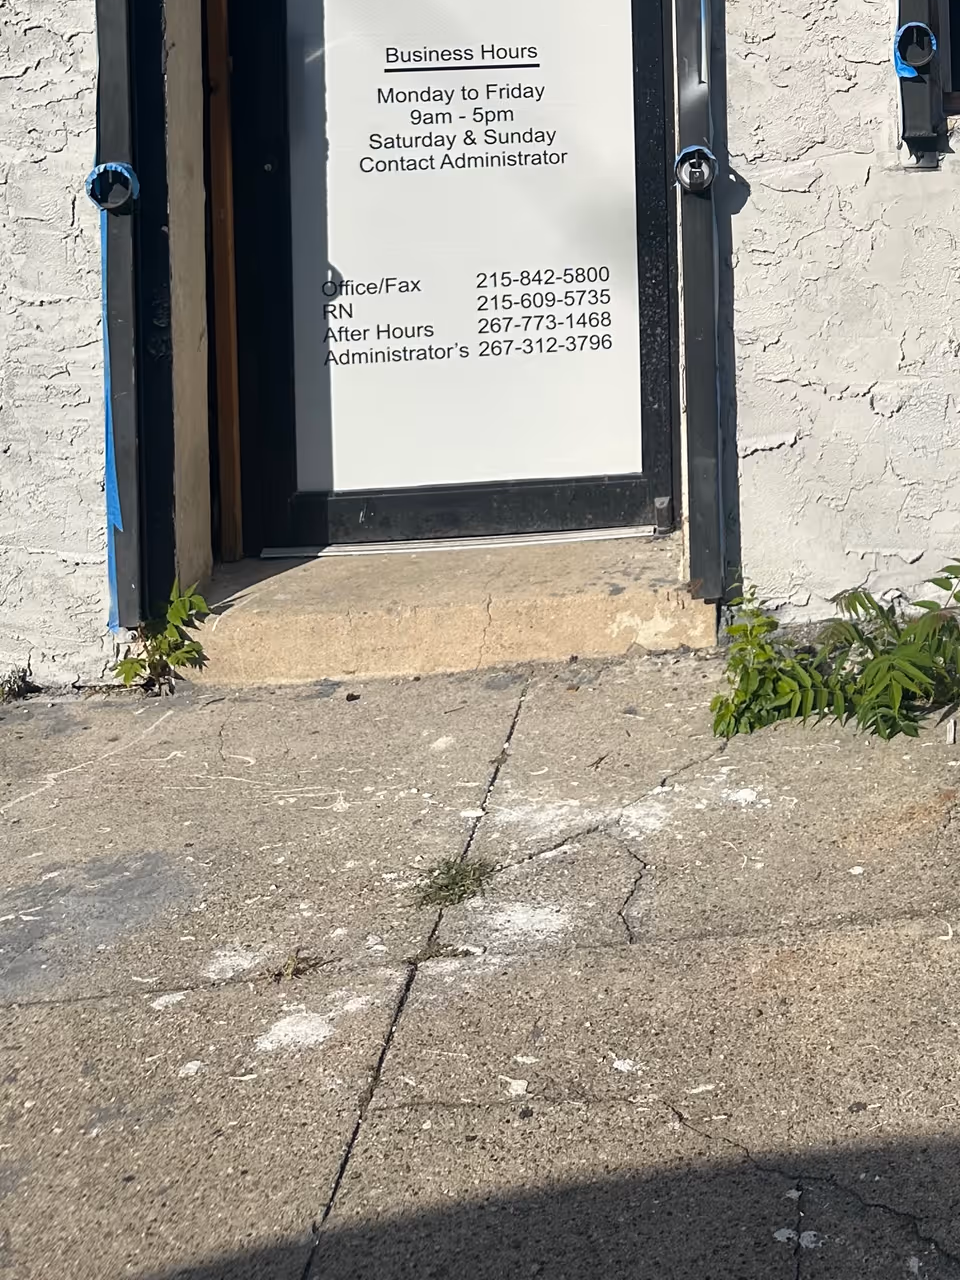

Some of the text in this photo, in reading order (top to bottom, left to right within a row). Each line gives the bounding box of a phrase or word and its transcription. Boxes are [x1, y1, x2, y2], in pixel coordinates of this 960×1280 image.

[385, 44, 538, 63] Business Hours
[377, 83, 545, 105] Monday to Friday
[410, 109, 452, 125] 9am
[472, 107, 514, 126] 5pm
[369, 127, 556, 151] Saturday & Sunday
[359, 150, 567, 173] Contact Administrator
[321, 266, 610, 297] Office/Fax 215-842-5800
[323, 288, 611, 320] RN 215-609-5735
[323, 311, 612, 343] After Hours 267-773-1468
[324, 333, 613, 366] Administrator's 267-312-3796
